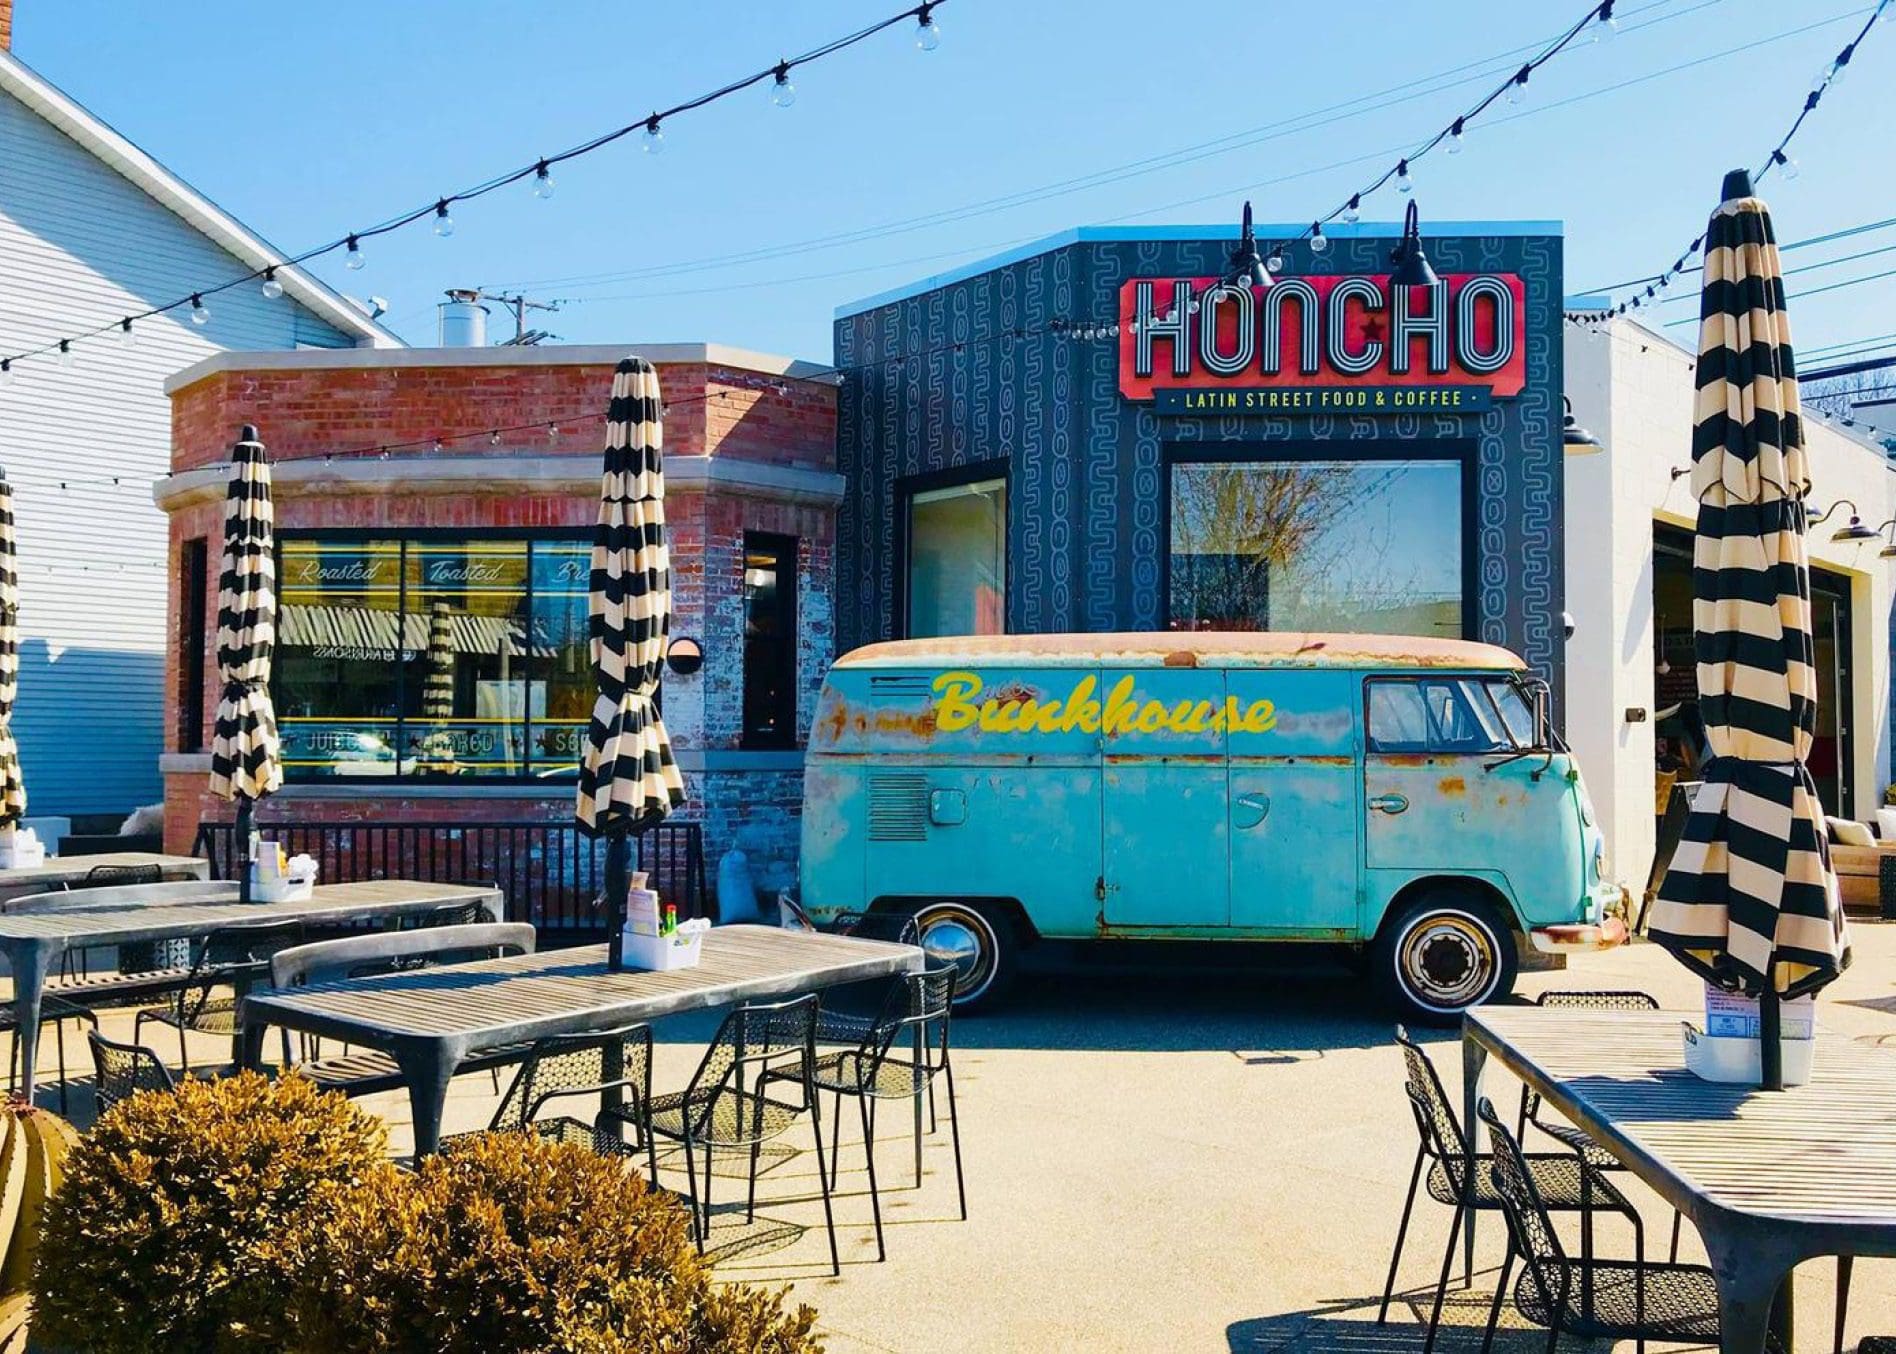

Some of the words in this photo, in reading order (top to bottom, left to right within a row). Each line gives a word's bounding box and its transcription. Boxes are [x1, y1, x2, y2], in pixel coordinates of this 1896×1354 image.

[1135, 275, 1515, 376] HONCHO
[1186, 393, 1237, 408] LATIN
[1246, 392, 1313, 407] STREET
[1322, 391, 1366, 407] FOOD
[1375, 391, 1385, 406] &
[1394, 391, 1461, 406] COFFEE
[299, 560, 383, 582] Roasted
[429, 560, 504, 582] Toasted
[551, 560, 591, 583] Bre
[932, 672, 1276, 734] Bunkhouse
